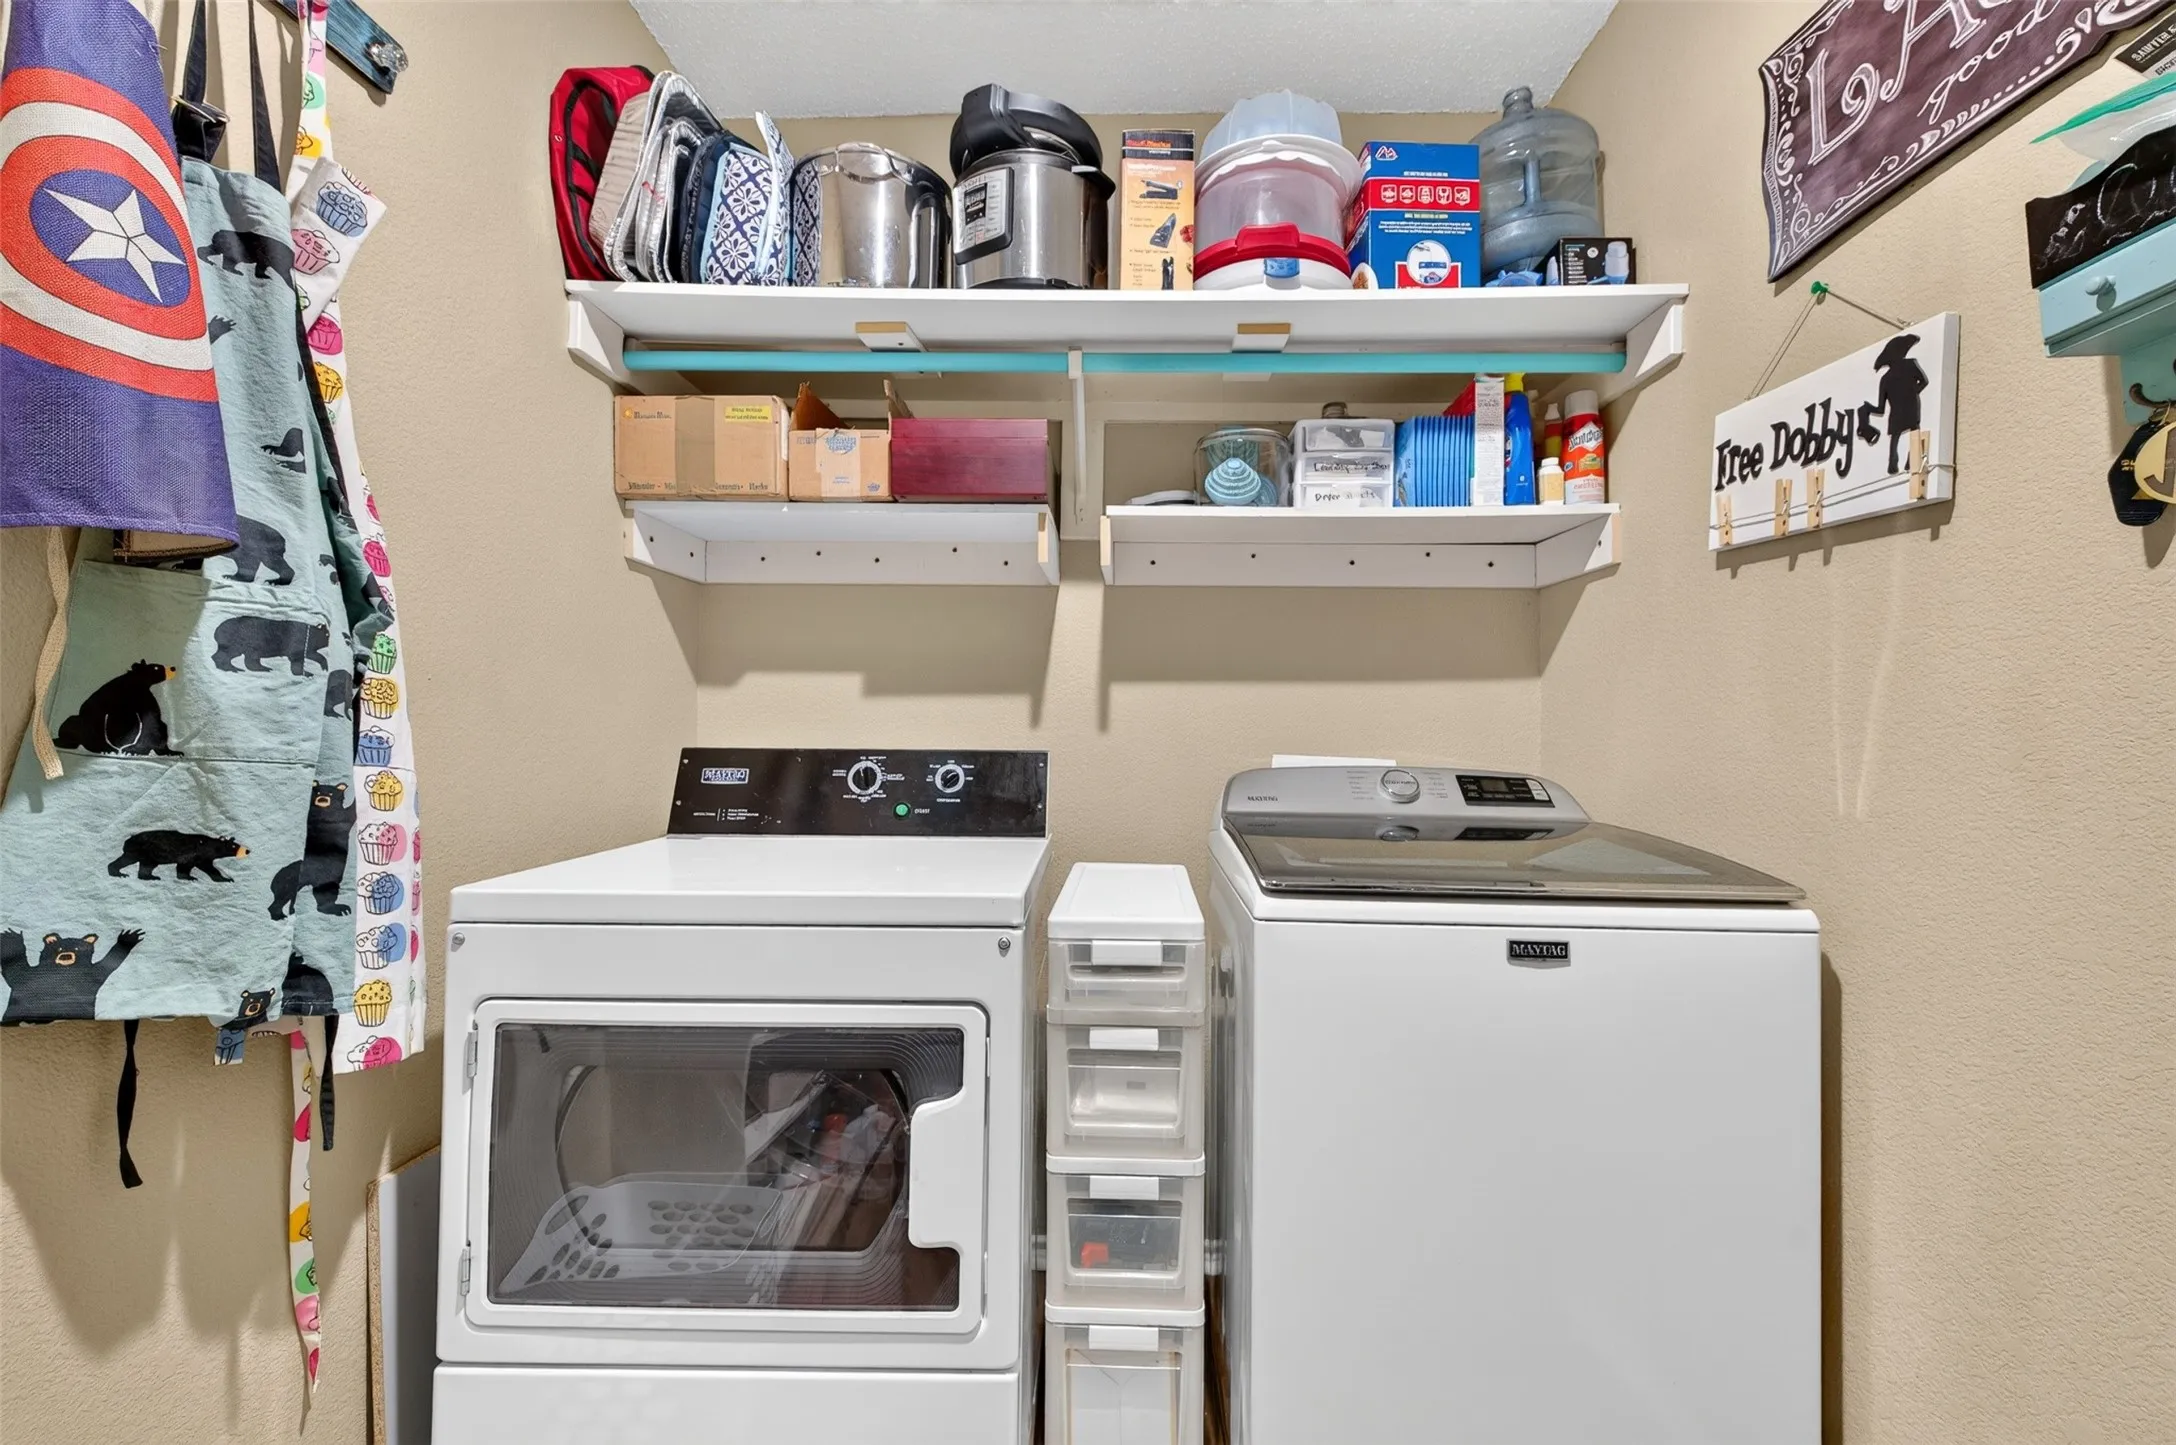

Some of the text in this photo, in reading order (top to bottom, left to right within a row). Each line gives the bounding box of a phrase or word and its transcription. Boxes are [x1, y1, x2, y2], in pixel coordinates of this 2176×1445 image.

[1805, 0, 2011, 165] LA
[1714, 397, 1854, 491] Free Dobby
[1512, 944, 1566, 956] MAYTAG
